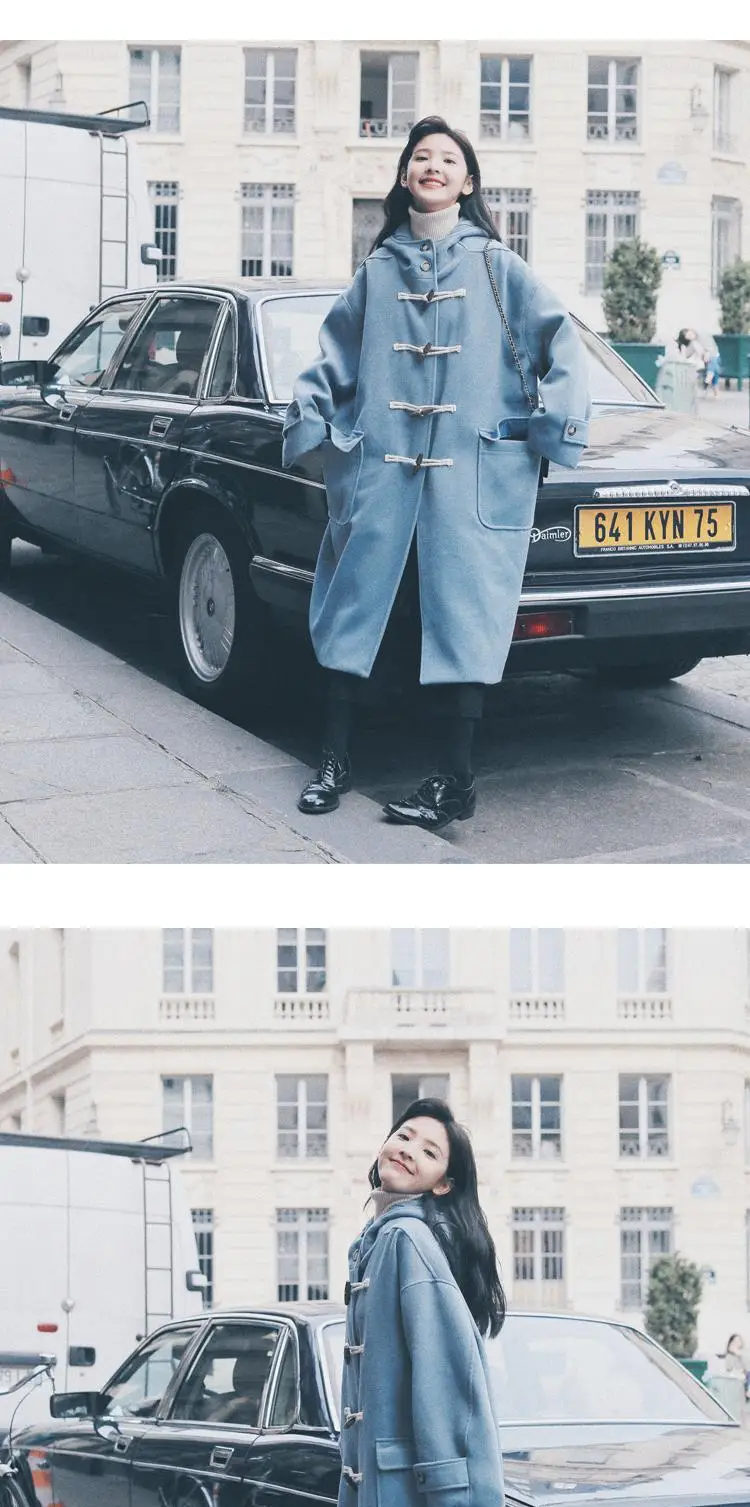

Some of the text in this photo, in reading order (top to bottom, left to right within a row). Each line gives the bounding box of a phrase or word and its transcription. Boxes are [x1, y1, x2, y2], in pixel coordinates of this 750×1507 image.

[530, 526, 572, 543] Daimler
[594, 508, 718, 543] 641 KYN 75
